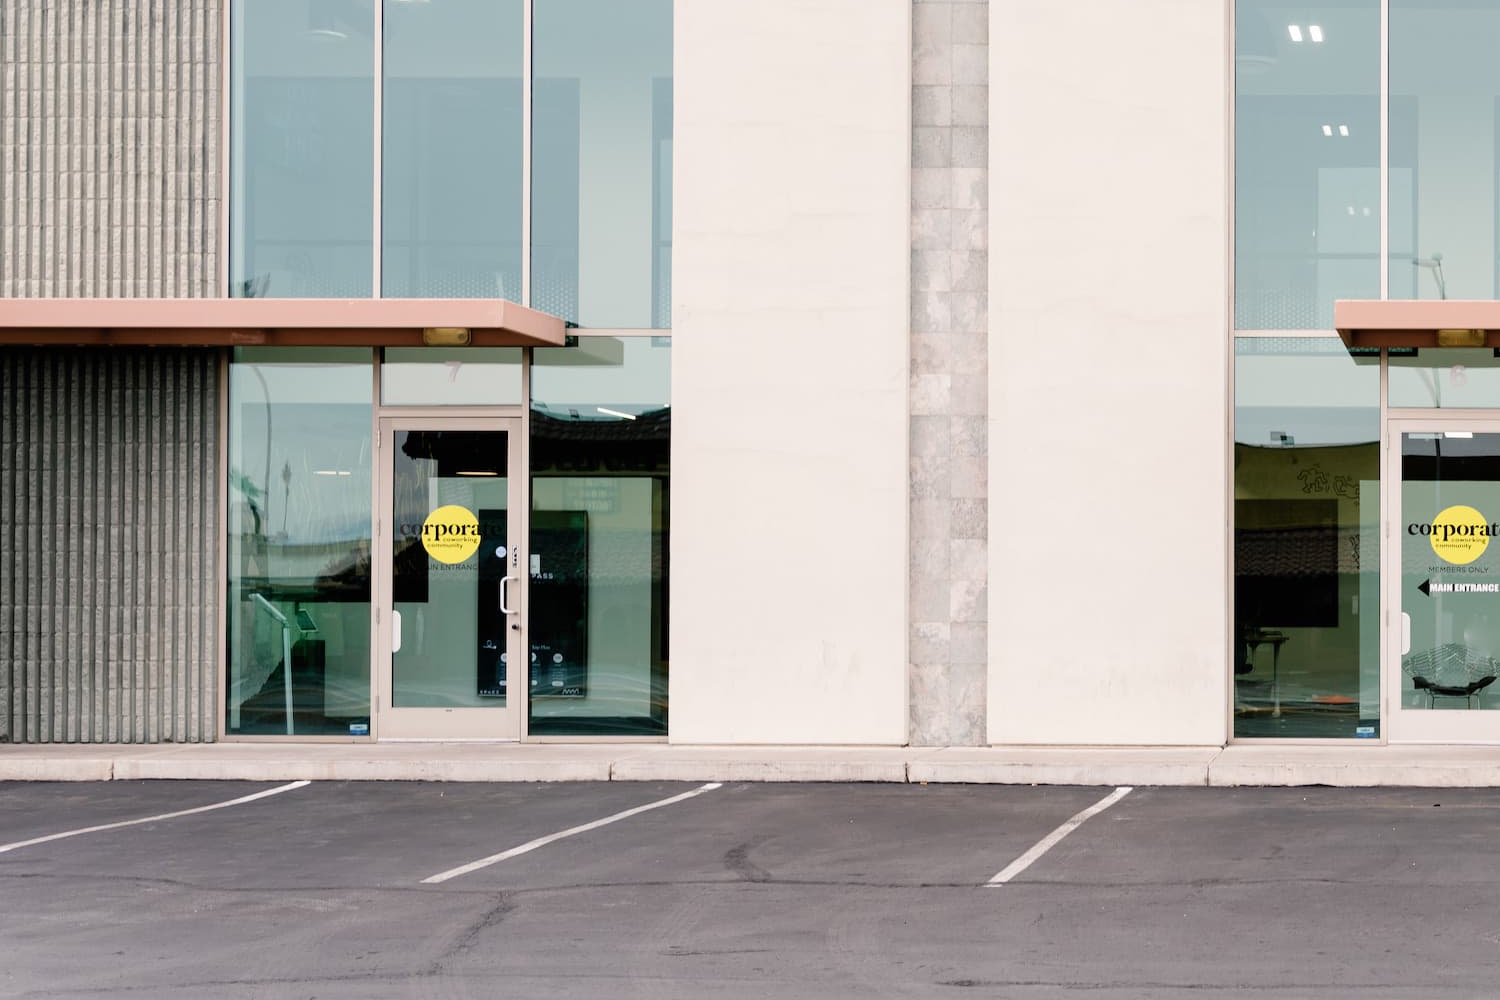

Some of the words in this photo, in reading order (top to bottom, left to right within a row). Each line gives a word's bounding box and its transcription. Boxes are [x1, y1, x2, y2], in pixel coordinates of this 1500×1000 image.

[445, 361, 463, 384] 7
[1450, 365, 1468, 388] 6
[1428, 566, 1466, 574] MEMBERS
[1468, 566, 1489, 574] ONLY
[1429, 583, 1453, 593] MAIN
[1454, 583, 1500, 593] ENTRANCE
